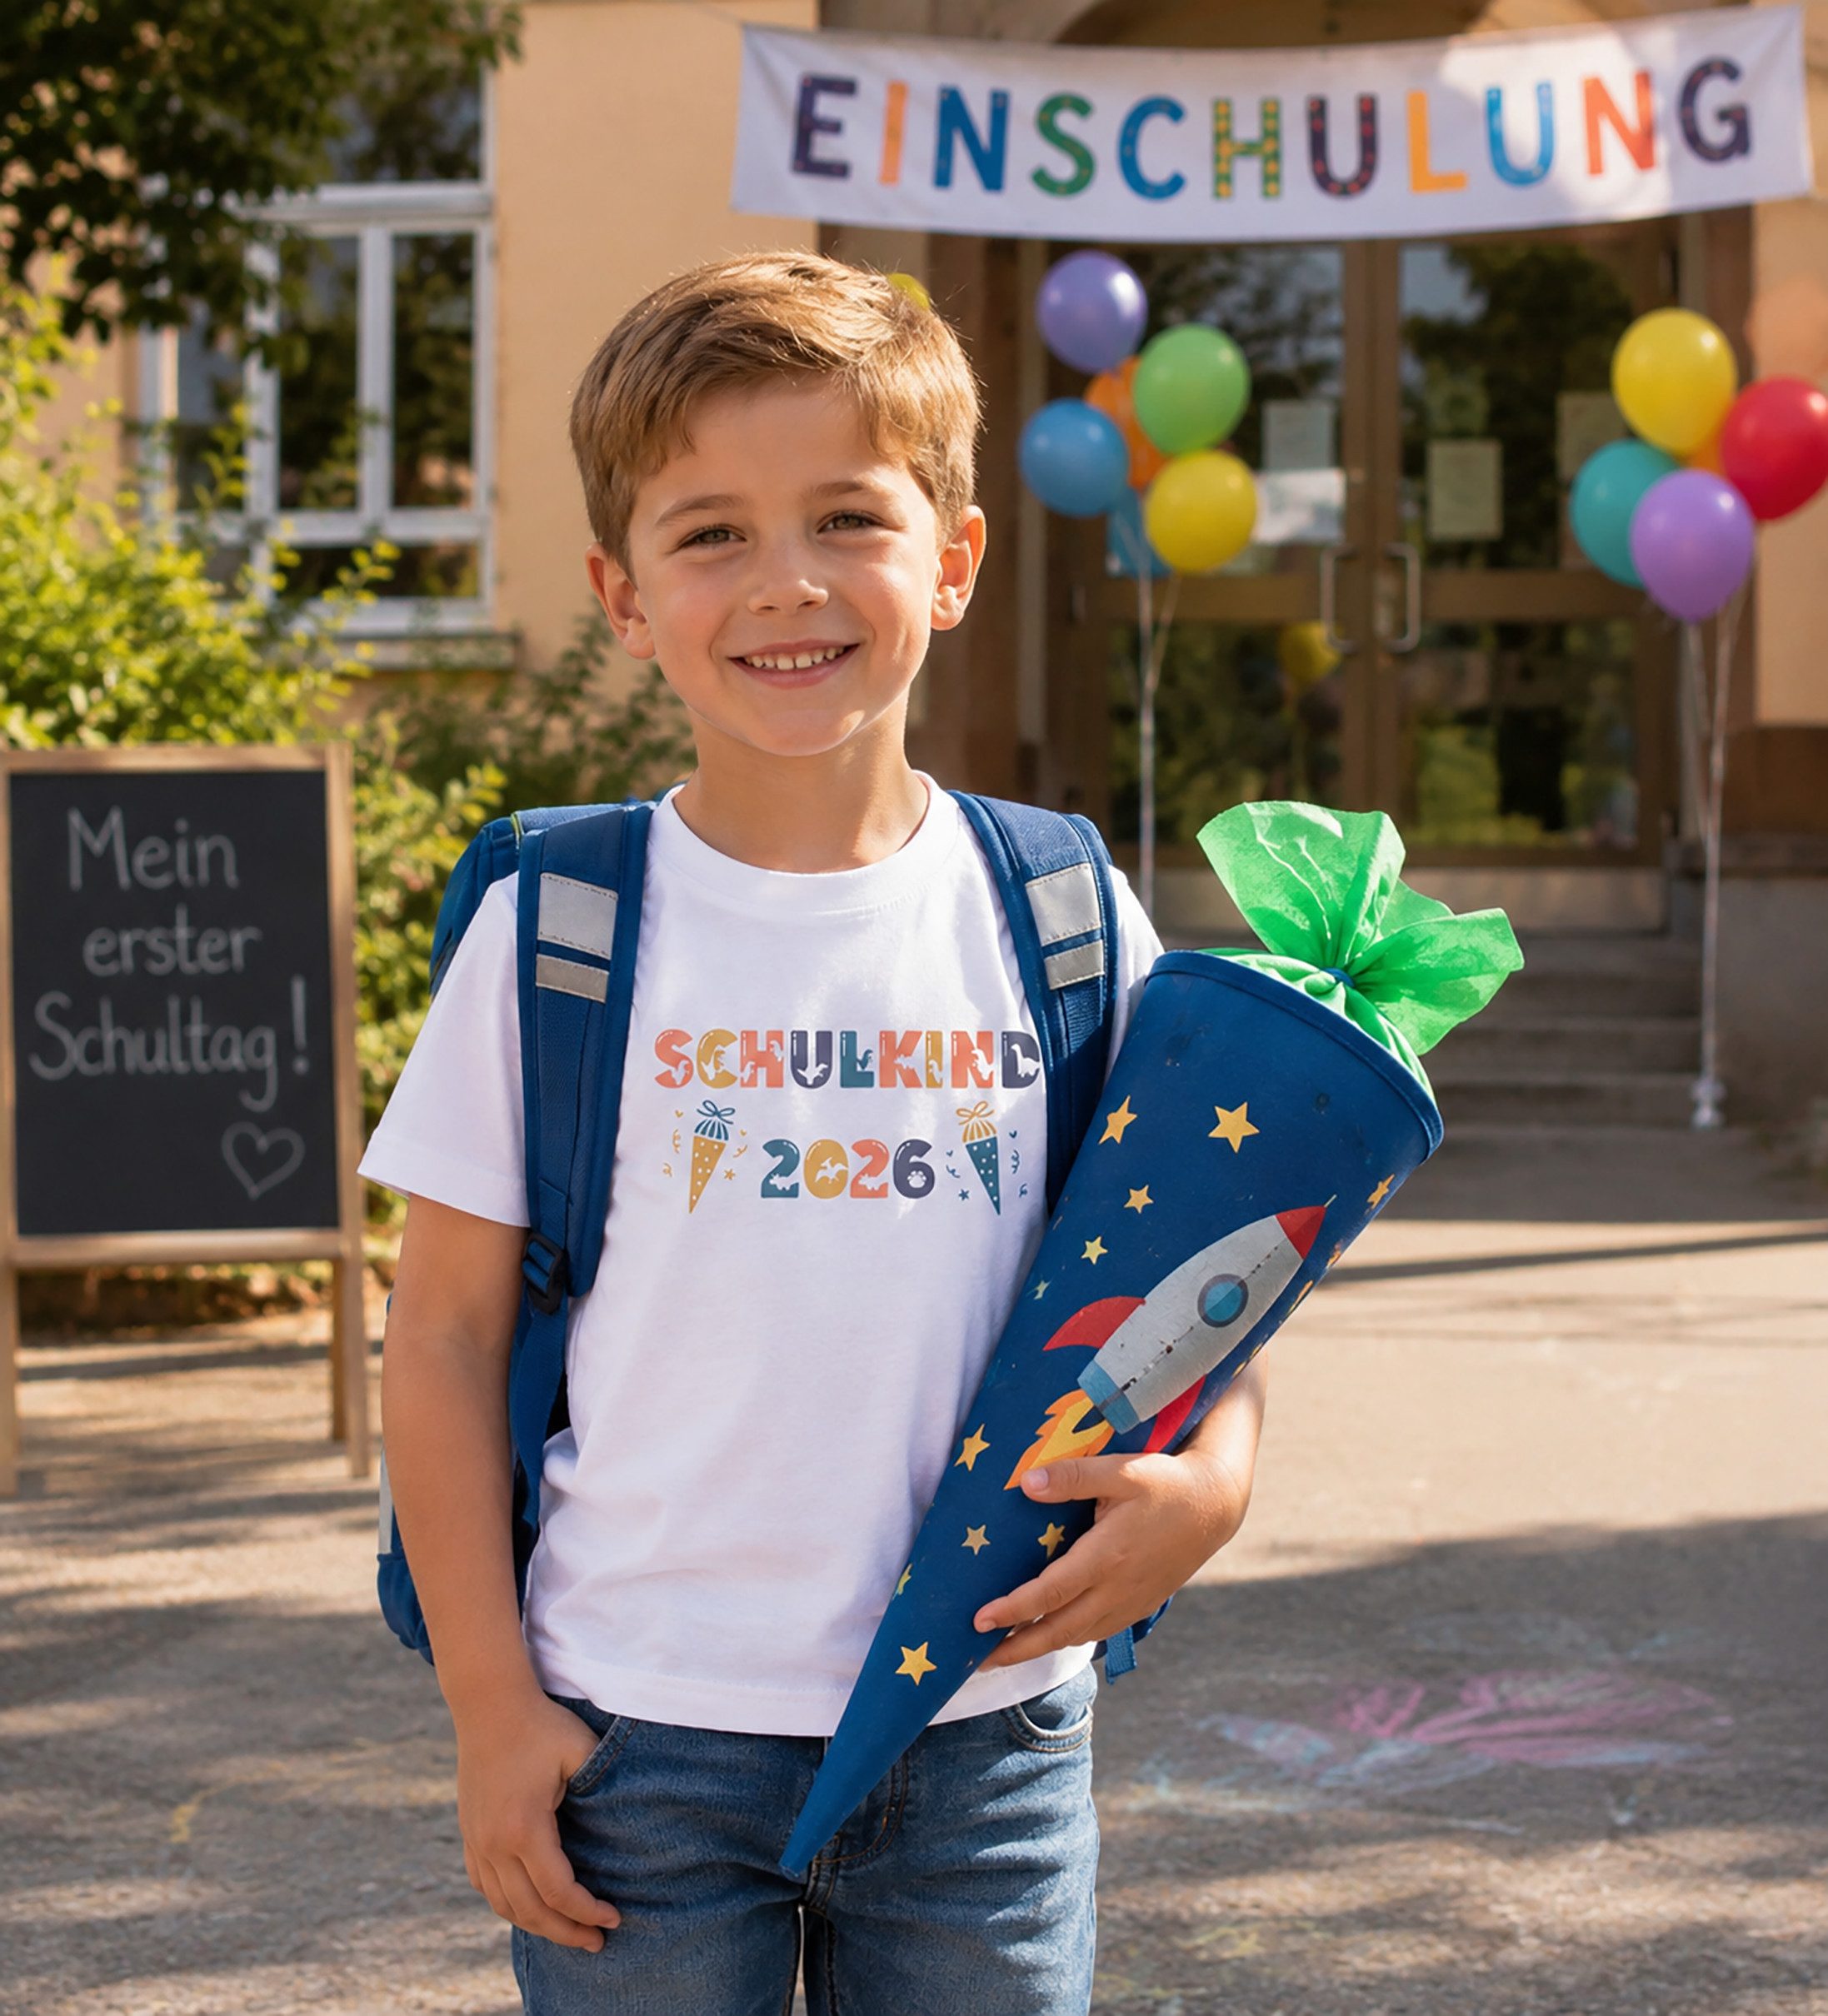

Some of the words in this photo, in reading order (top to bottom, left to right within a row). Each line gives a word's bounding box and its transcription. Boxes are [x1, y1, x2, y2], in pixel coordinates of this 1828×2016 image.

[792, 59, 1751, 199] EINSCHULUNG
[68, 806, 239, 891] Mein
[84, 903, 262, 975] erster
[30, 975, 307, 1112] Schultag!
[654, 1029, 1041, 1089] SCHULKIND
[761, 1139, 935, 1199] 2026
